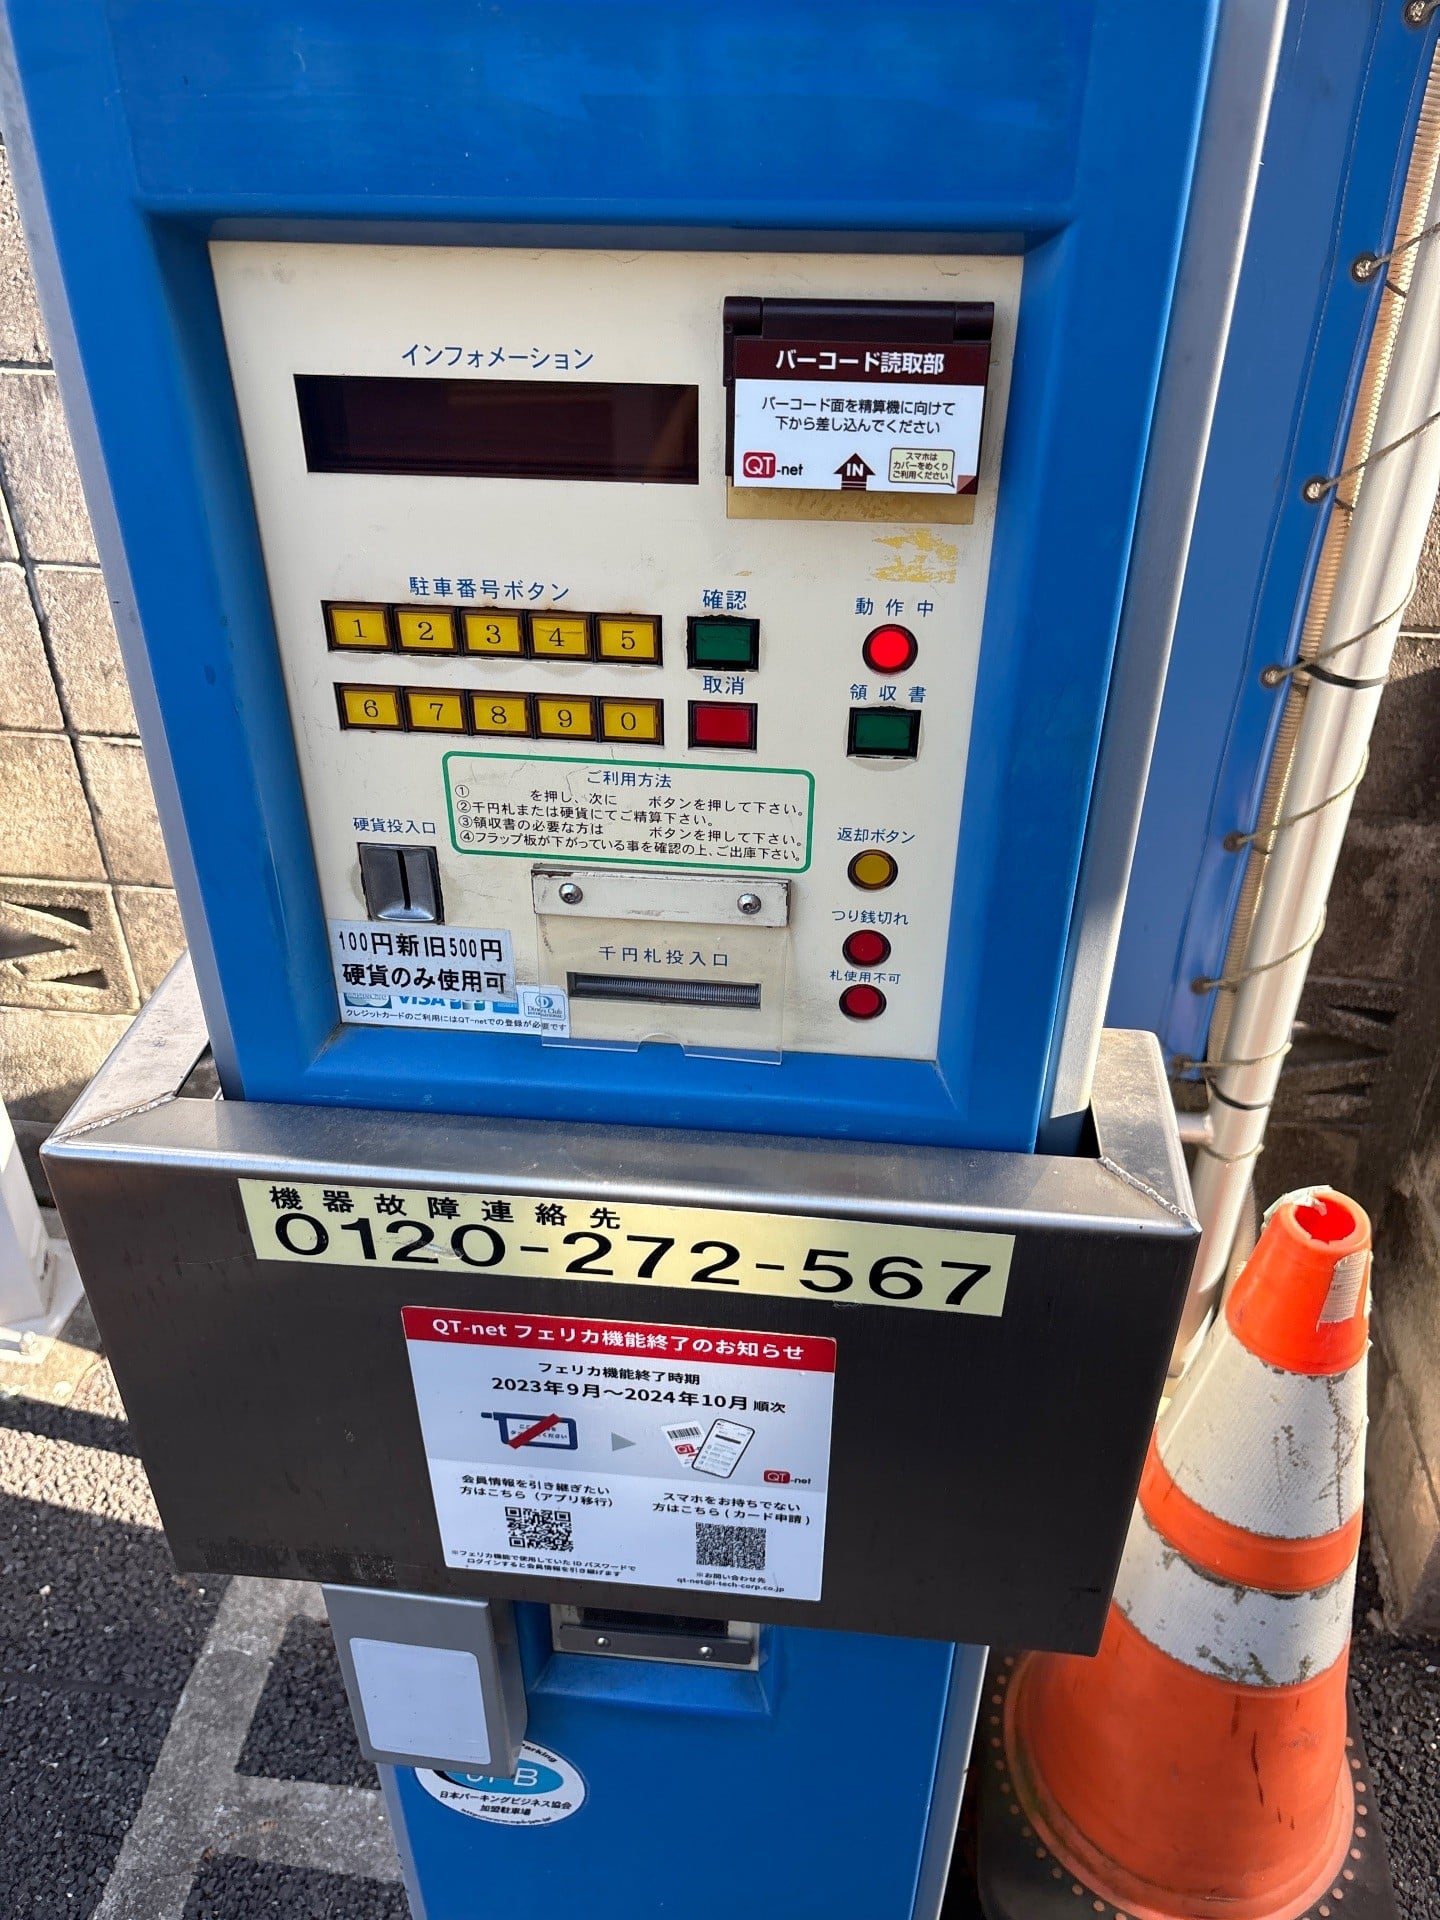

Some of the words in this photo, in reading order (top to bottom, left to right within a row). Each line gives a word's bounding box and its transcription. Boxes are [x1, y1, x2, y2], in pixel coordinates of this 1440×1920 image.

[402, 343, 594, 370] インフォメーション
[776, 350, 945, 375] バーコード読取部
[762, 396, 956, 417] バーコード面を精算機に向けて
[775, 416, 940, 434] 下から差し込んでください
[893, 462, 948, 471] カバーをめくり
[906, 452, 938, 461] スマホは
[846, 463, 864, 477] IN
[893, 470, 949, 480] ご利用ください
[408, 576, 570, 601] 駐車番号ボタン
[702, 589, 747, 610] 確認
[352, 619, 367, 638] 1
[417, 621, 434, 641] 2
[485, 624, 501, 644] 3
[549, 628, 565, 647] 4
[621, 630, 636, 650] 5
[703, 676, 744, 695] 取消
[363, 700, 379, 718] 6
[429, 703, 443, 721] 7
[491, 706, 507, 725] 8
[557, 709, 572, 728] 9
[620, 712, 636, 730] 0
[586, 770, 672, 788] ご利用方法
[648, 796, 805, 818] ボタンを押して下さい。
[353, 817, 436, 835] 硬貨投入口
[457, 814, 604, 836] ③領収書の必要な方は
[648, 827, 803, 848] ボタンを押して下さい。
[837, 826, 916, 844] 返却ボタン
[831, 909, 909, 926] つり銭切れ
[338, 930, 503, 962] 100円新旧500円
[599, 946, 729, 967] 千円札投入口
[342, 962, 507, 994] 硬貨のみ使用可
[829, 968, 902, 985] 札使用不可
[274, 1212, 991, 1306] 0120-272-567
[432, 1319, 507, 1338] QT-net
[514, 1323, 805, 1360] フェリカ機能終了のお知らせ
[538, 1362, 701, 1386] フェリカ機能終了時期
[753, 1401, 786, 1414] 順次
[462, 1474, 610, 1495] 会員情報を引き継ぎたい
[663, 1492, 801, 1512] スマホをお持ちでない
[440, 1790, 572, 1810] 日本パーキングビジネス協会
[480, 1804, 531, 1816] 加盟駐車場
